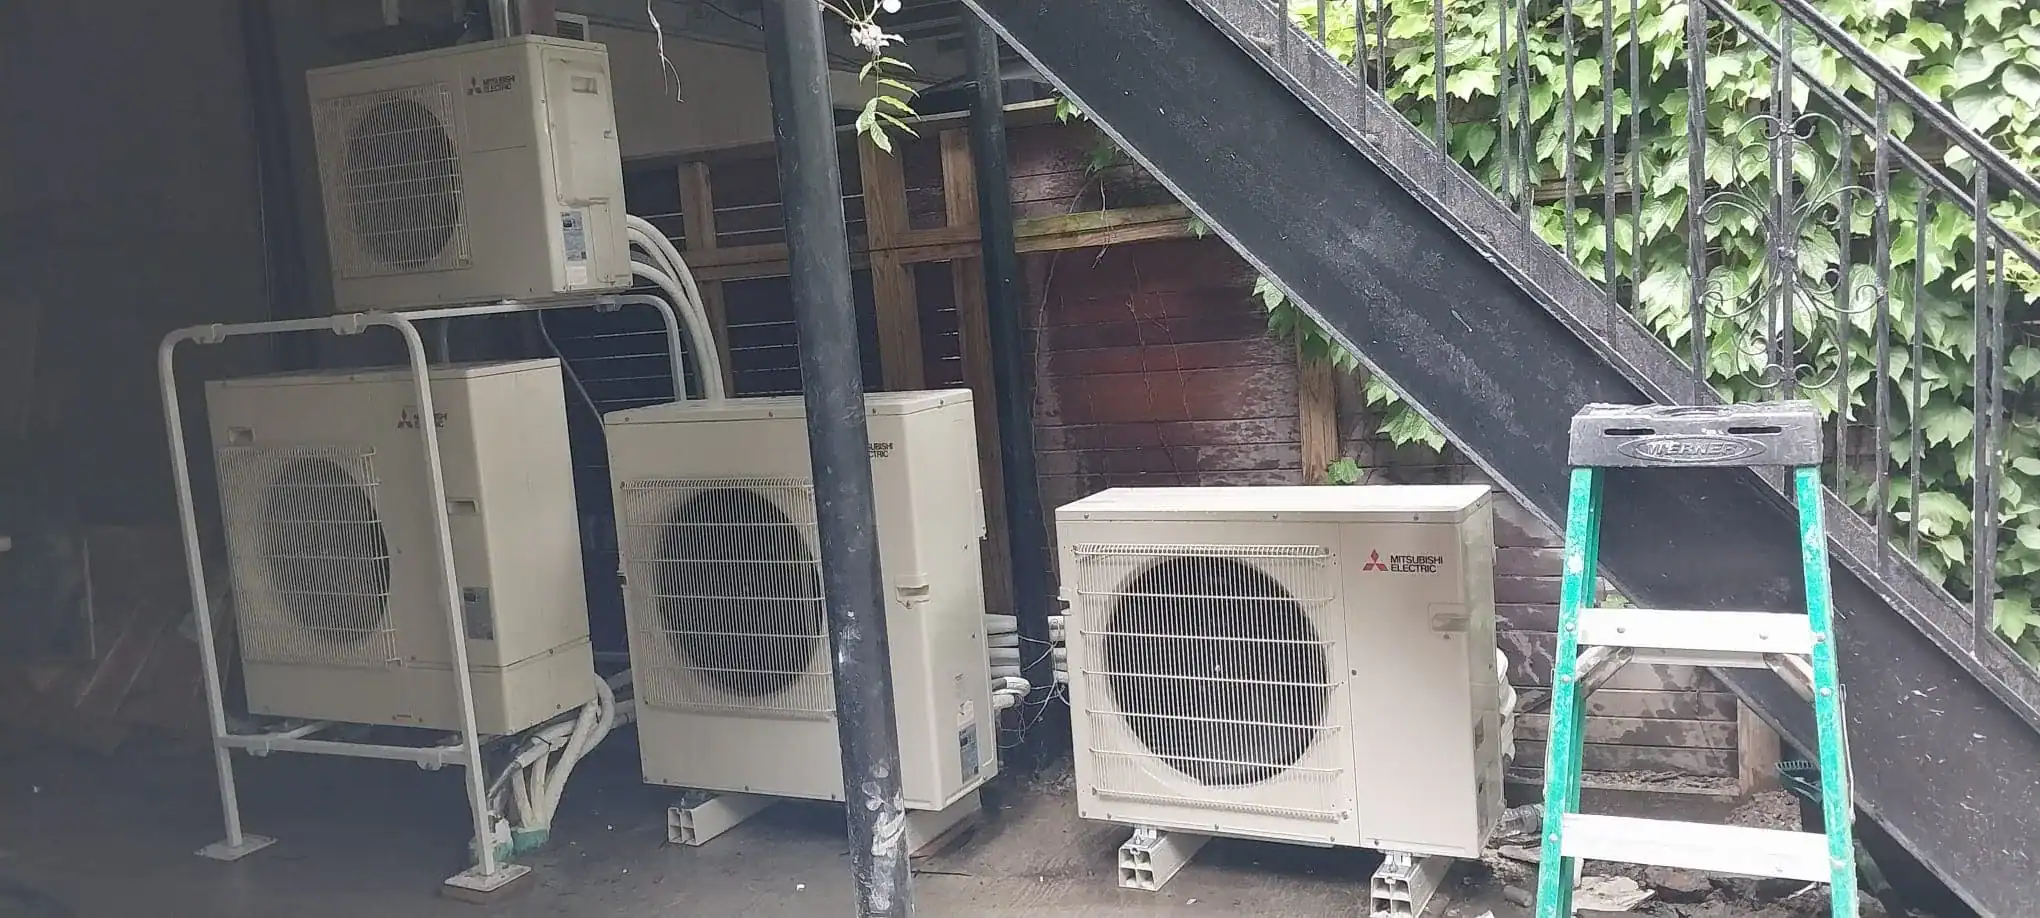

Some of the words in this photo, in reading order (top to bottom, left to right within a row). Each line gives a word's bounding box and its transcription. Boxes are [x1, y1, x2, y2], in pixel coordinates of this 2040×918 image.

[1646, 440, 1738, 456] WERNER
[1390, 555, 1443, 565] MITSUBISHI
[1390, 563, 1437, 573] ELECTRIC
